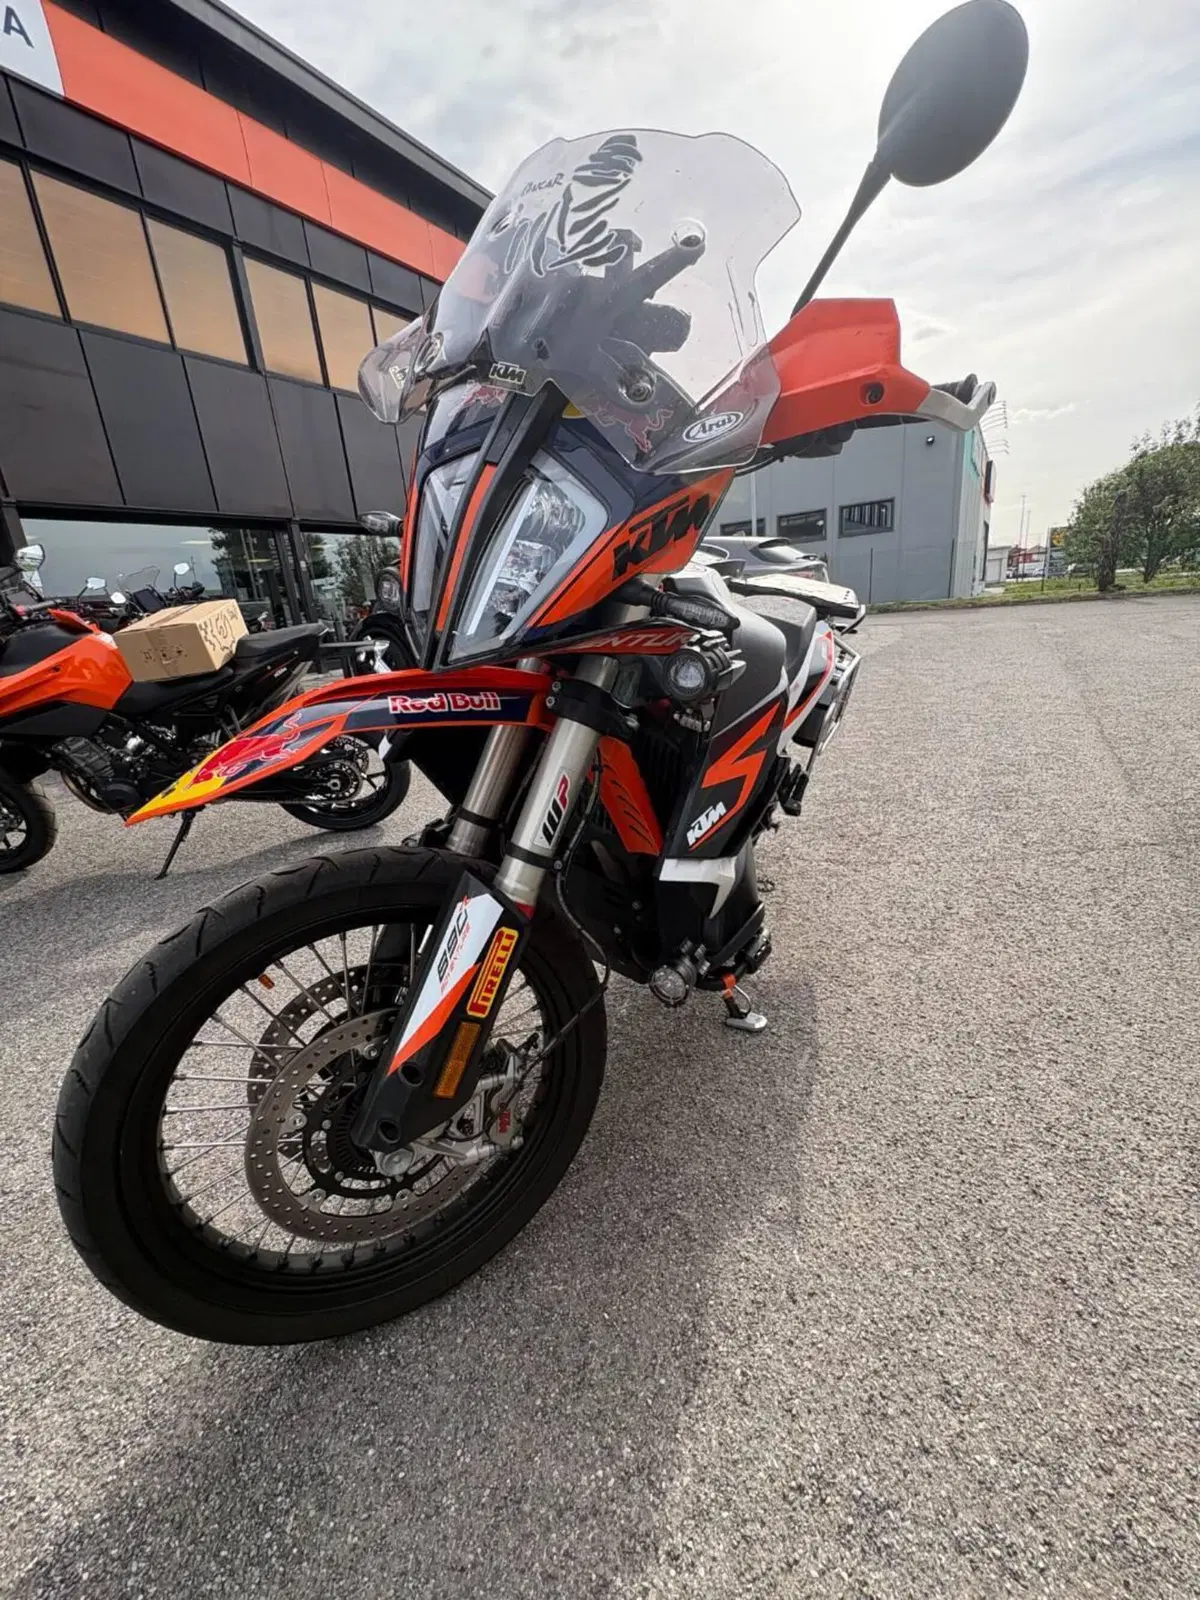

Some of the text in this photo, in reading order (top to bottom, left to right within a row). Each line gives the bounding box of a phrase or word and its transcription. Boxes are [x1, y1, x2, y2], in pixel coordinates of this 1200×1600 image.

[490, 361, 526, 384] KTM
[691, 413, 736, 440] Arai
[612, 494, 711, 581] KTM
[388, 692, 501, 714] Red Bull
[686, 801, 728, 846] KTM
[437, 908, 468, 983] 890
[469, 930, 516, 1016] PIRELLI
